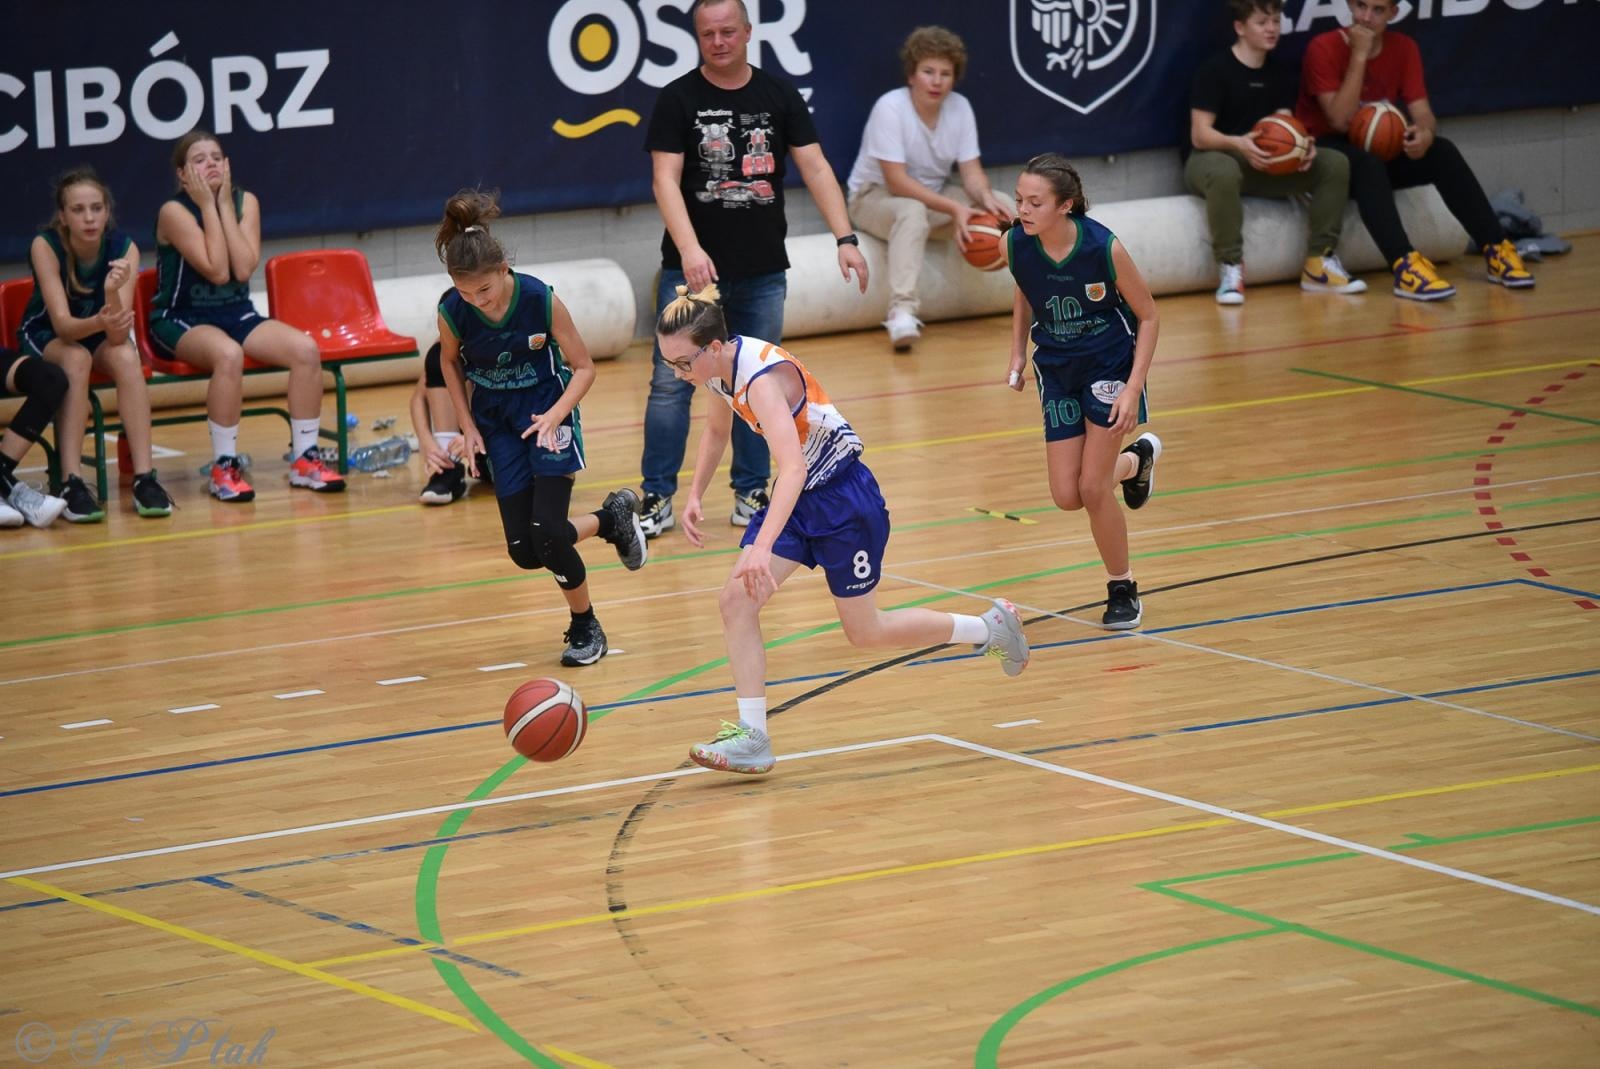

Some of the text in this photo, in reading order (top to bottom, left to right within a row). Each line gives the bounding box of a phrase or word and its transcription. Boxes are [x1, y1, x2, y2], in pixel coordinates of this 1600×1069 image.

[548, 0, 813, 95] OSR
[1045, 295, 1083, 322] 10
[1046, 398, 1081, 429] 10
[853, 550, 871, 579] 8
